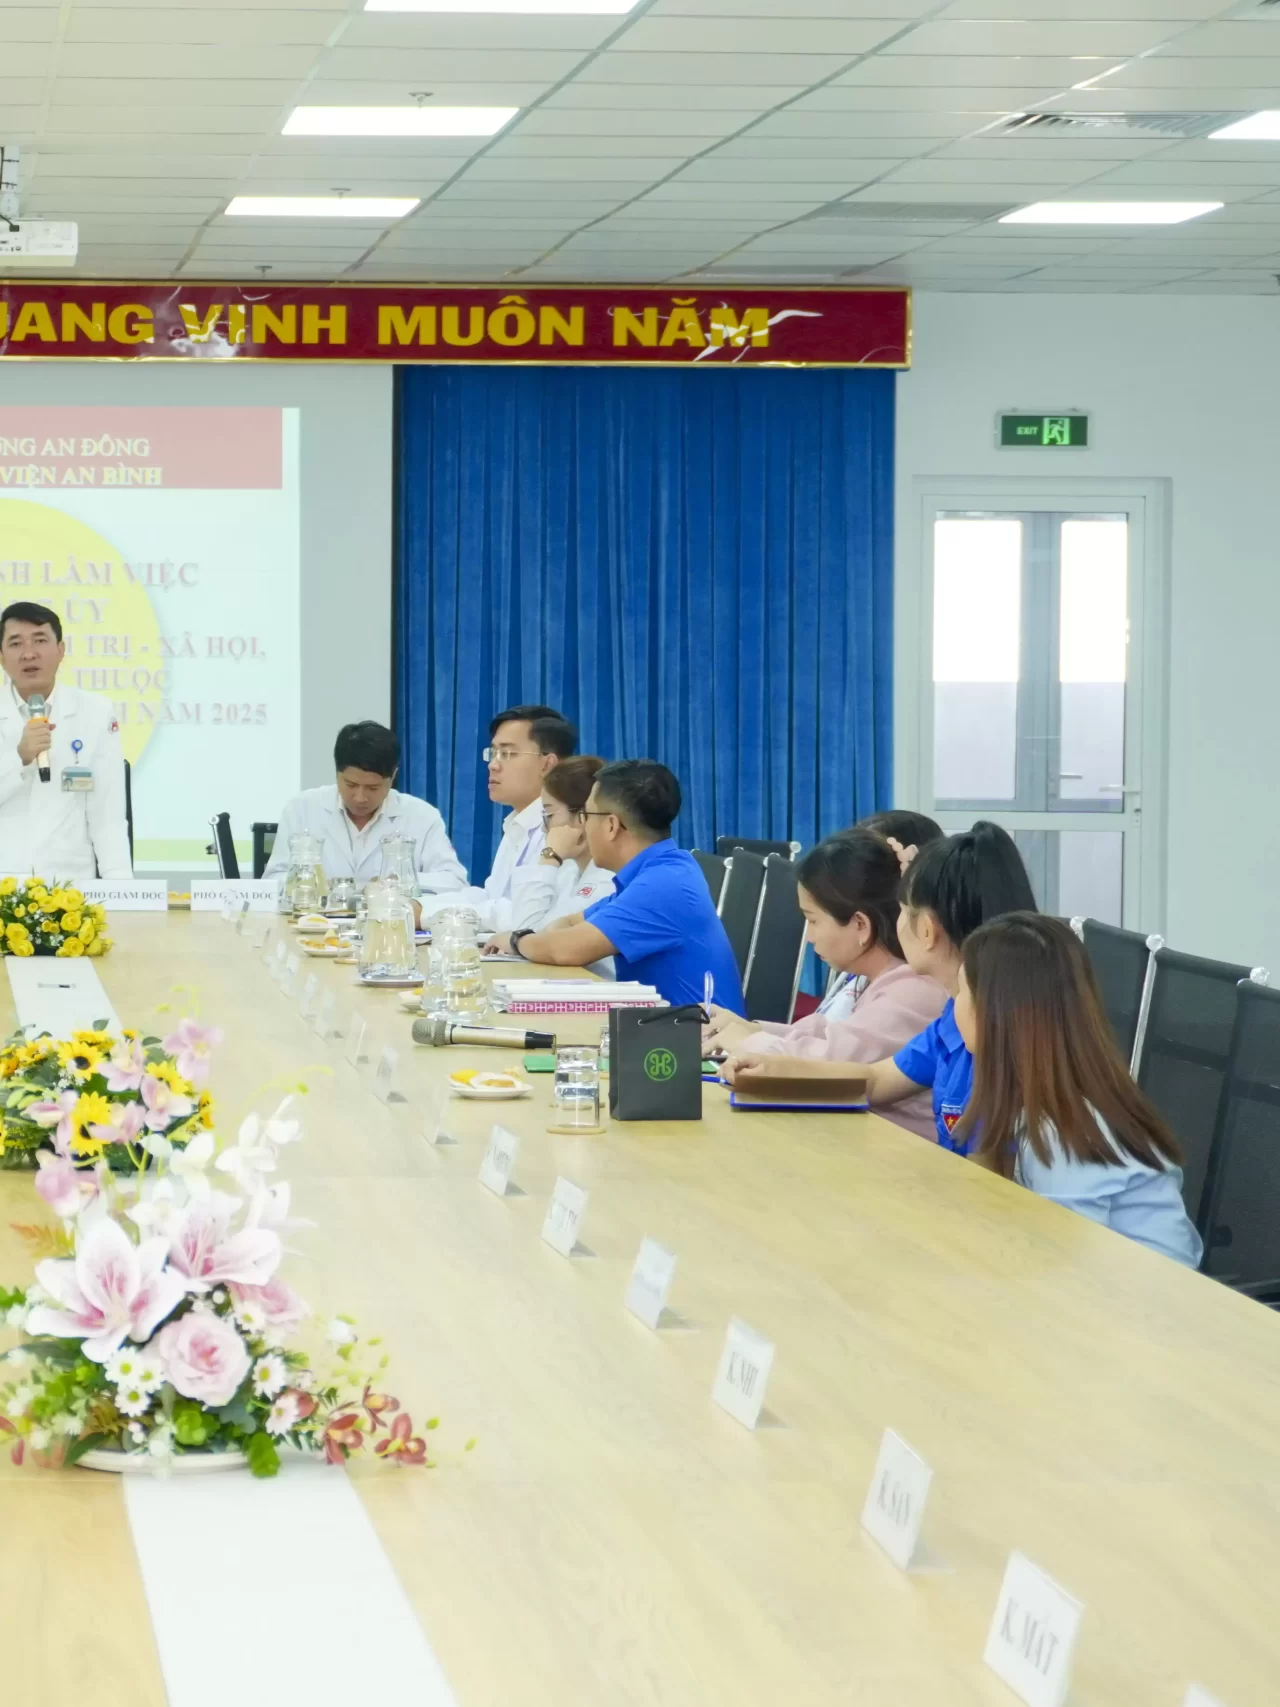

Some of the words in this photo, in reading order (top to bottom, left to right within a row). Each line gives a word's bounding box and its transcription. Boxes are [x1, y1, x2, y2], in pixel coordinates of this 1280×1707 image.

[178, 303, 348, 345] VINH
[377, 295, 584, 347] MUÔN
[612, 297, 770, 348] NĂM
[40, 437, 78, 458] AN
[81, 433, 150, 458] ĐÔNG
[1016, 426, 1039, 436] EXIT
[61, 465, 96, 486] AN
[102, 461, 163, 486] BÌNH
[40, 555, 114, 588] LÀM
[123, 558, 200, 592] VIỆC
[75, 664, 173, 694] THUỘC
[137, 697, 203, 726] NĂM
[211, 702, 269, 726] 2025
